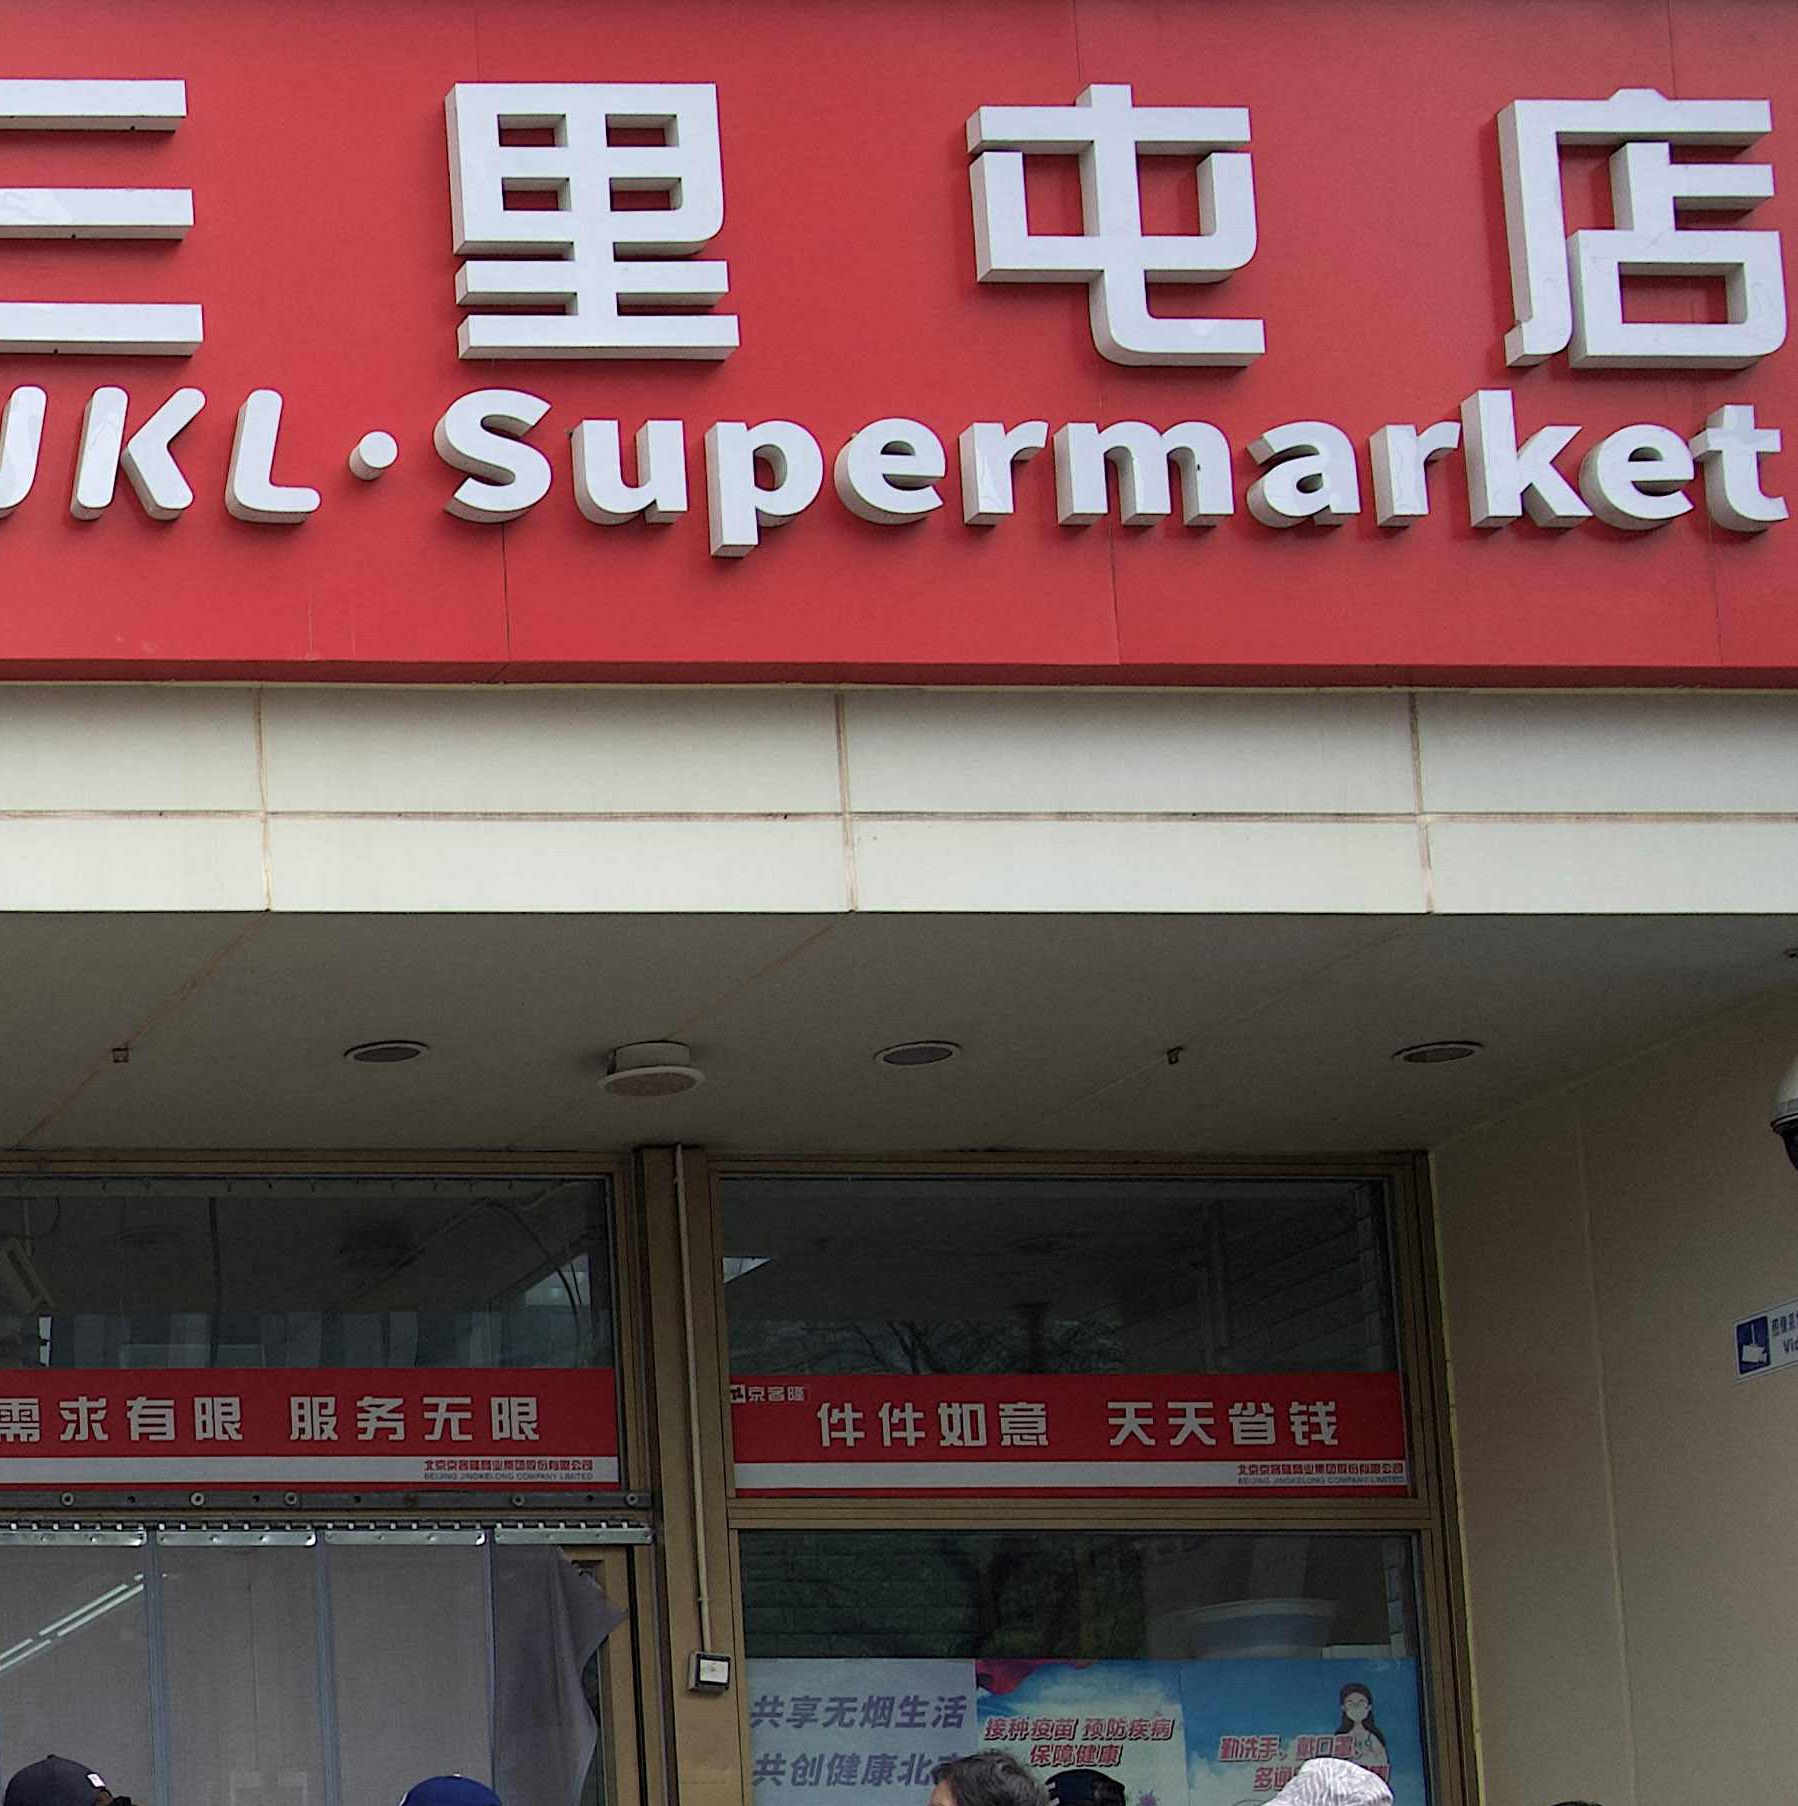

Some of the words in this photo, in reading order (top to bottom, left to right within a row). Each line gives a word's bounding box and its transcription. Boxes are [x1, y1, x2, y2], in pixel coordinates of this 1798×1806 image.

[747, 1386, 805, 1402] 京客隆
[290, 1396, 540, 1441] 服务无限
[816, 1401, 1049, 1447] 件件如意
[1107, 1401, 1339, 1446] 天天省钱
[750, 1695, 967, 1729] 共享无烟生活
[984, 1717, 1077, 1740] 接种疫苗
[1082, 1717, 1175, 1741] 预防疾病
[752, 1752, 963, 1787] 共创健康北
[1030, 1743, 1124, 1767] 保障健康
